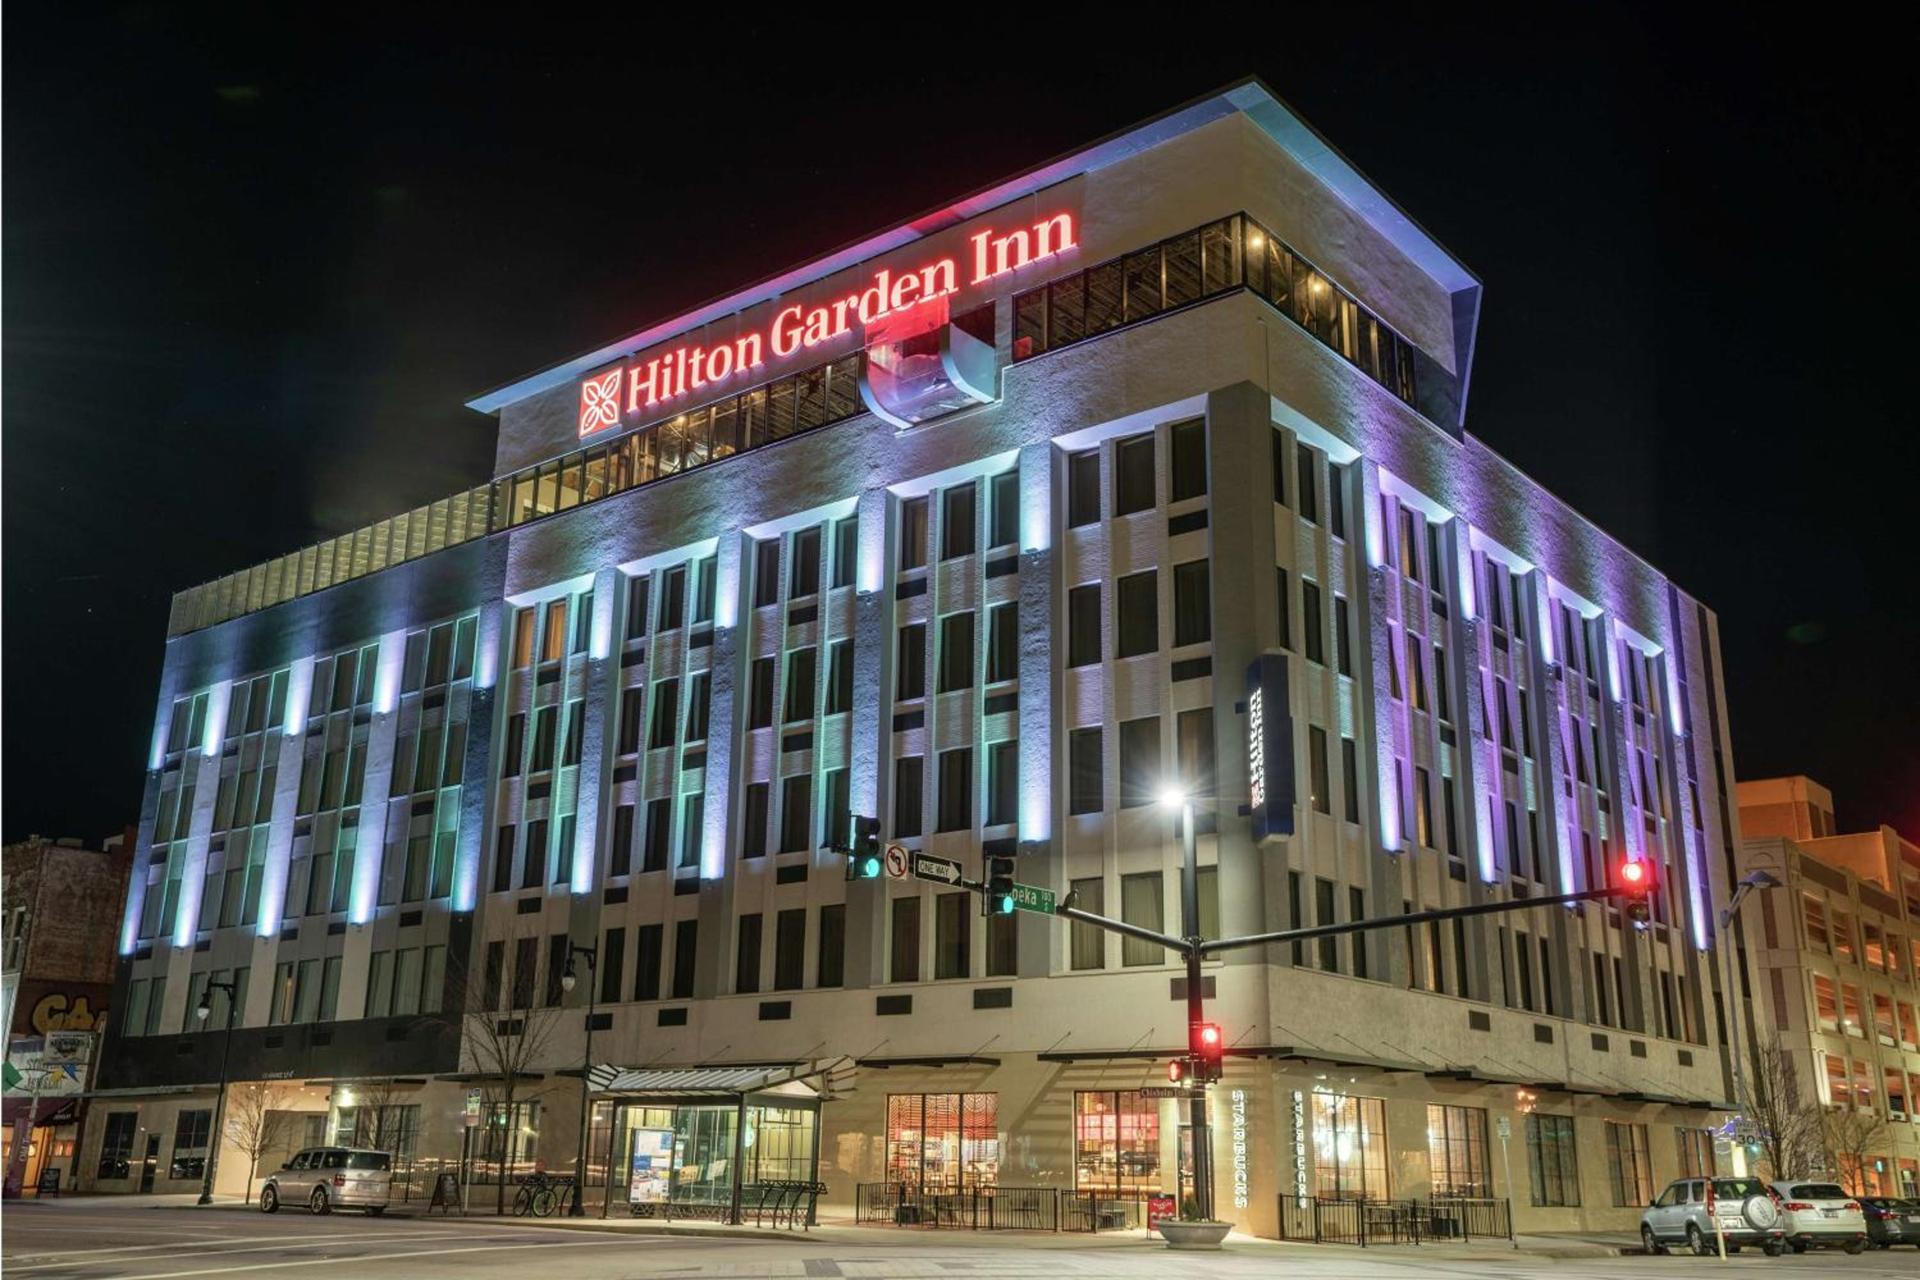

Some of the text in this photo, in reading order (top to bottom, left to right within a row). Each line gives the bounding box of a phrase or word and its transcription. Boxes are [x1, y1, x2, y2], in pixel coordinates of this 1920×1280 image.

[627, 211, 1078, 414] Hilton Garden Inn
[920, 860, 949, 877] ONE WAY
[1009, 887, 1037, 906] peka
[1232, 1090, 1248, 1209] STARBUCKS
[1294, 1091, 1307, 1209] STARBUCKS
[1738, 1135, 1755, 1145] 30
